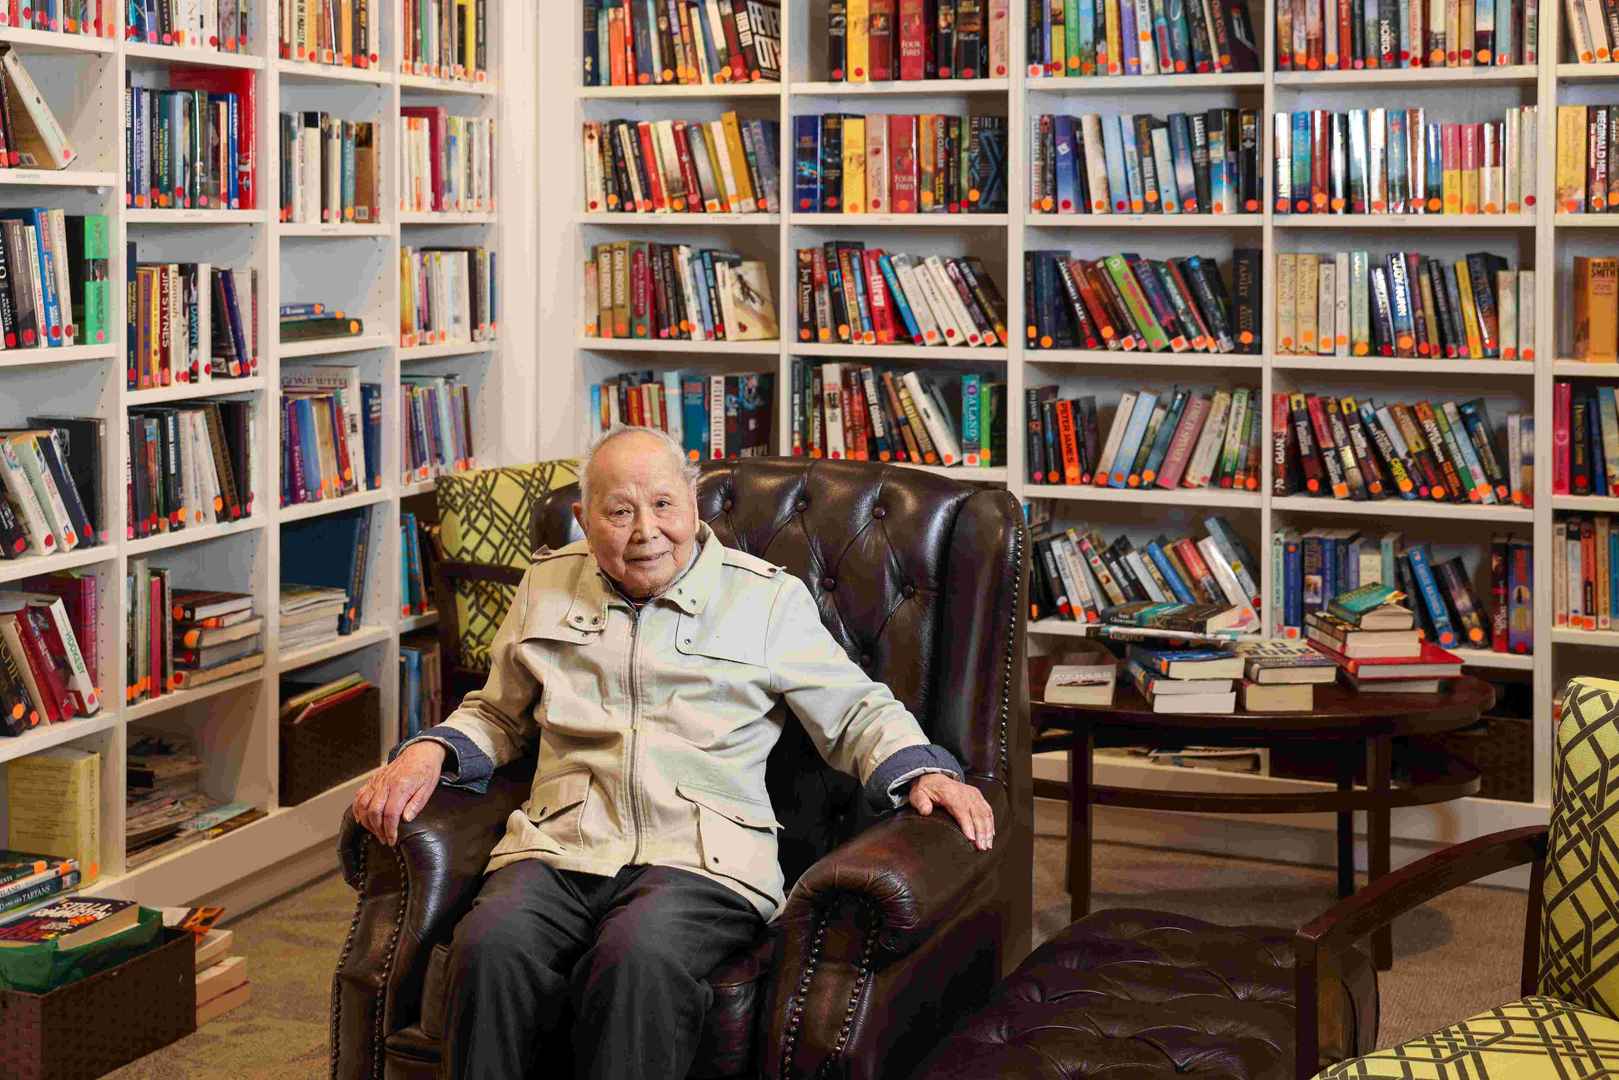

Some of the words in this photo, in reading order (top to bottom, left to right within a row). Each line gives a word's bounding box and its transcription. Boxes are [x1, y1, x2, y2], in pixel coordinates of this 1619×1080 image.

[1596, 110, 1606, 158] REGINALD
[1596, 159, 1606, 181] HILL
[602, 252, 611, 271] DAN
[615, 250, 624, 267] DAN
[1392, 257, 1404, 283] JUDY
[161, 272, 170, 293] JIM
[602, 271, 611, 307] BROWN
[615, 267, 624, 304] BROWN
[1239, 257, 1248, 297] FAMILY
[161, 296, 170, 348] STYNES
[190, 305, 199, 344] DAWN
[316, 375, 348, 385] WITH
[1060, 402, 1070, 430] PETER
[1064, 431, 1075, 463] JAMES
[1275, 438, 1285, 464] NYPD
